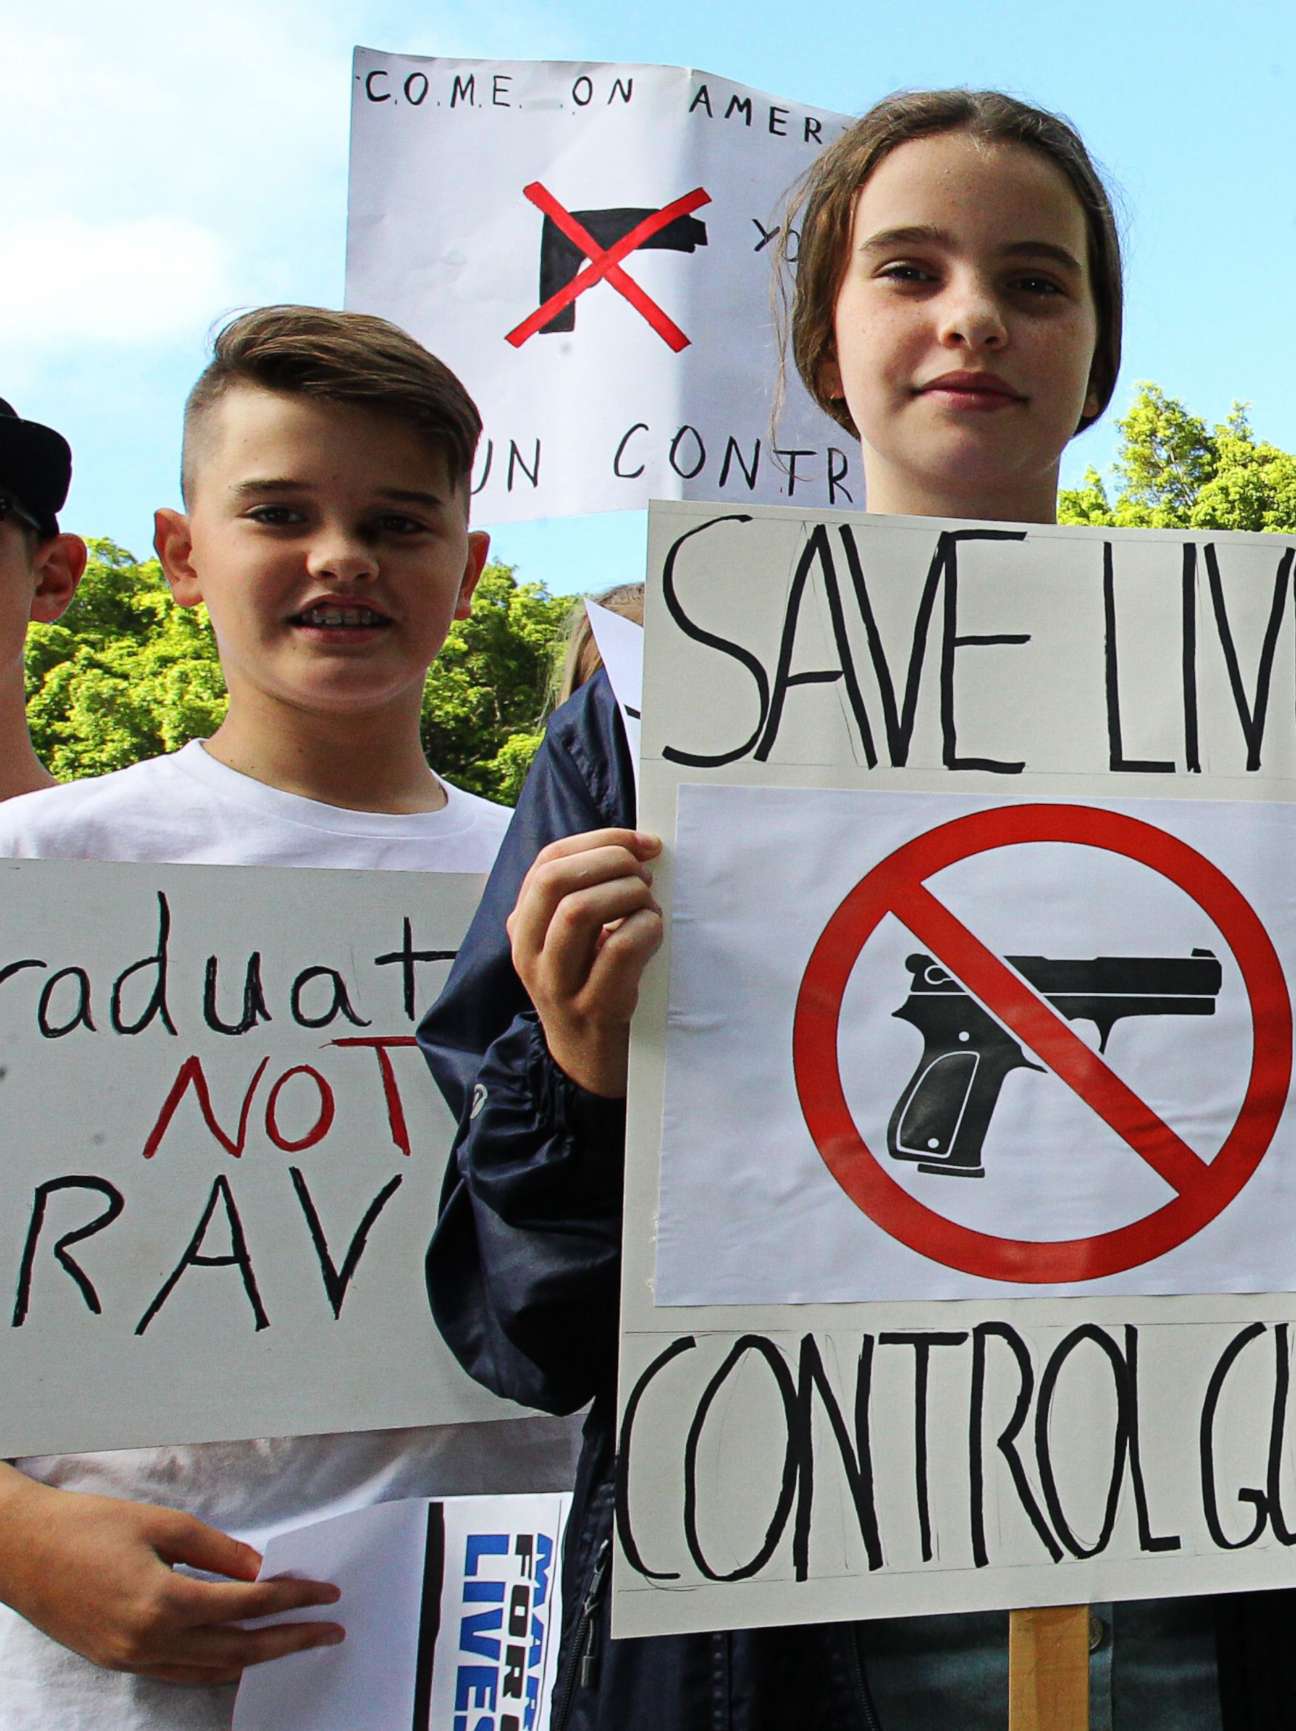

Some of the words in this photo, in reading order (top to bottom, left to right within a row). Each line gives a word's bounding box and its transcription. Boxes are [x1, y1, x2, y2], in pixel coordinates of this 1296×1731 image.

[689, 85, 849, 144] AMER
[613, 423, 853, 504] CONTR
[662, 514, 1031, 769] SAVE
[142, 1035, 420, 1159] NOT
[11, 1166, 403, 1336] RAV
[615, 1320, 1181, 1582] CONTROL
[503, 1534, 534, 1699] FOR
